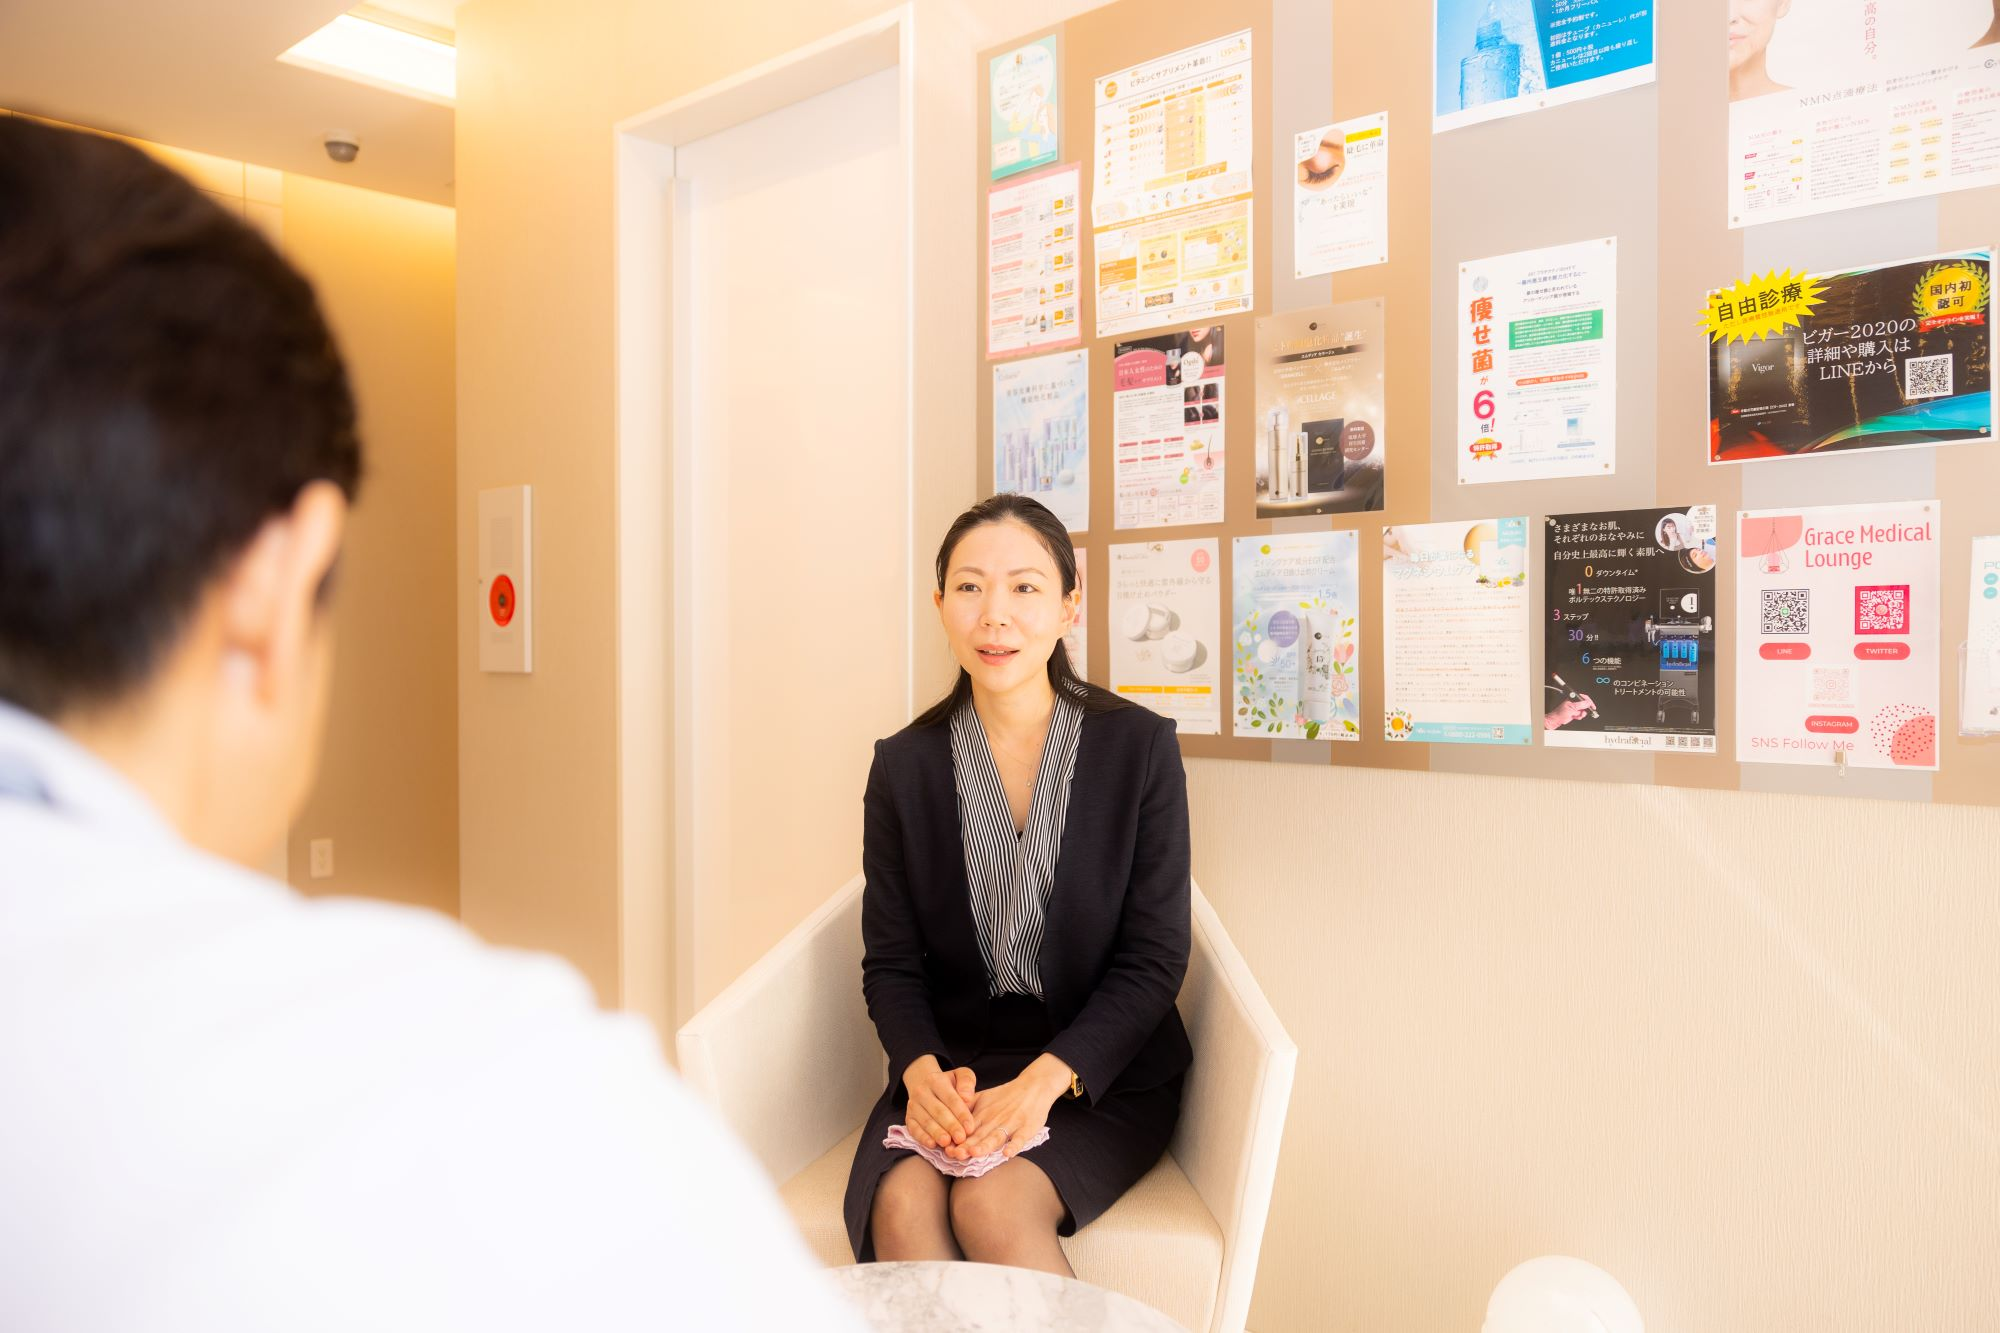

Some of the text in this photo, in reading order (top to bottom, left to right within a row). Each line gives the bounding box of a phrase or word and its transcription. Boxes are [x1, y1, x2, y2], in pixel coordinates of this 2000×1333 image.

[1799, 83, 1878, 108] NMN点滴療法
[1929, 280, 1972, 297] 国内初
[1717, 282, 1804, 323] 自由診療
[1936, 295, 1965, 310] 認可
[1802, 318, 1917, 345] ビガー2020の
[1807, 337, 1912, 365] 詳細や購入は
[1752, 363, 1775, 374] Vigor
[1819, 358, 1897, 381] LINEから
[1554, 521, 1622, 532] さまざまなお肌、
[1553, 531, 1645, 544] それぞれのおなやみに
[1804, 521, 1932, 546] Grace Medical
[1554, 547, 1665, 560] 自分史上最高に輝く素肌へ
[1805, 549, 1873, 570] Lounge
[1585, 565, 1593, 578] 0
[1553, 609, 1589, 621] 3 ステップ
[1568, 630, 1583, 641] 30
[1582, 653, 1622, 665] 6 つの機能
[1613, 688, 1687, 696] トリートメントの可能性
[1811, 720, 1853, 728] INSTAGRAM
[1751, 737, 1855, 751] SNS Follow Me
